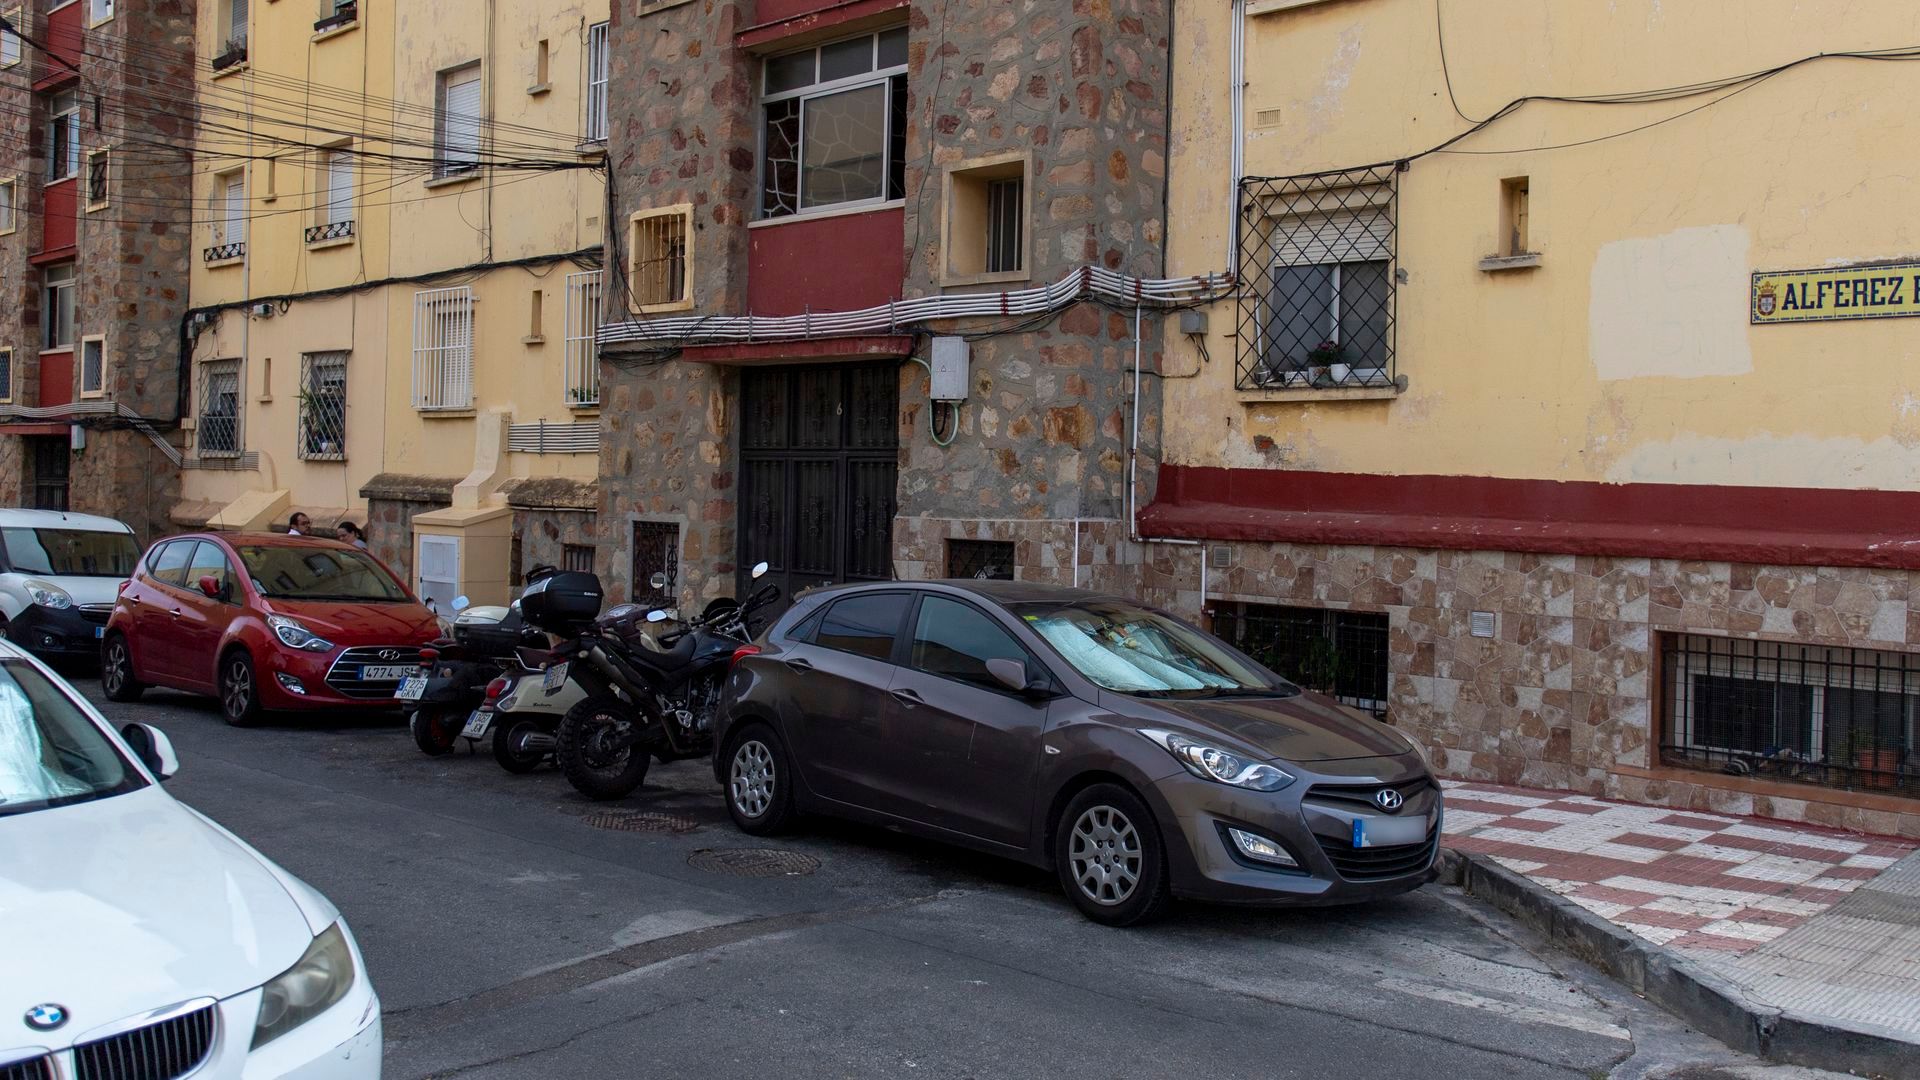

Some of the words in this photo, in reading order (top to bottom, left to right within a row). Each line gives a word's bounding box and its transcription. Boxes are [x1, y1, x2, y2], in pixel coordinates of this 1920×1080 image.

[1782, 277, 1903, 310] ALFEREZ
[366, 667, 393, 678] 4774
[405, 680, 425, 689] 7275
[400, 688, 417, 698] GKN
